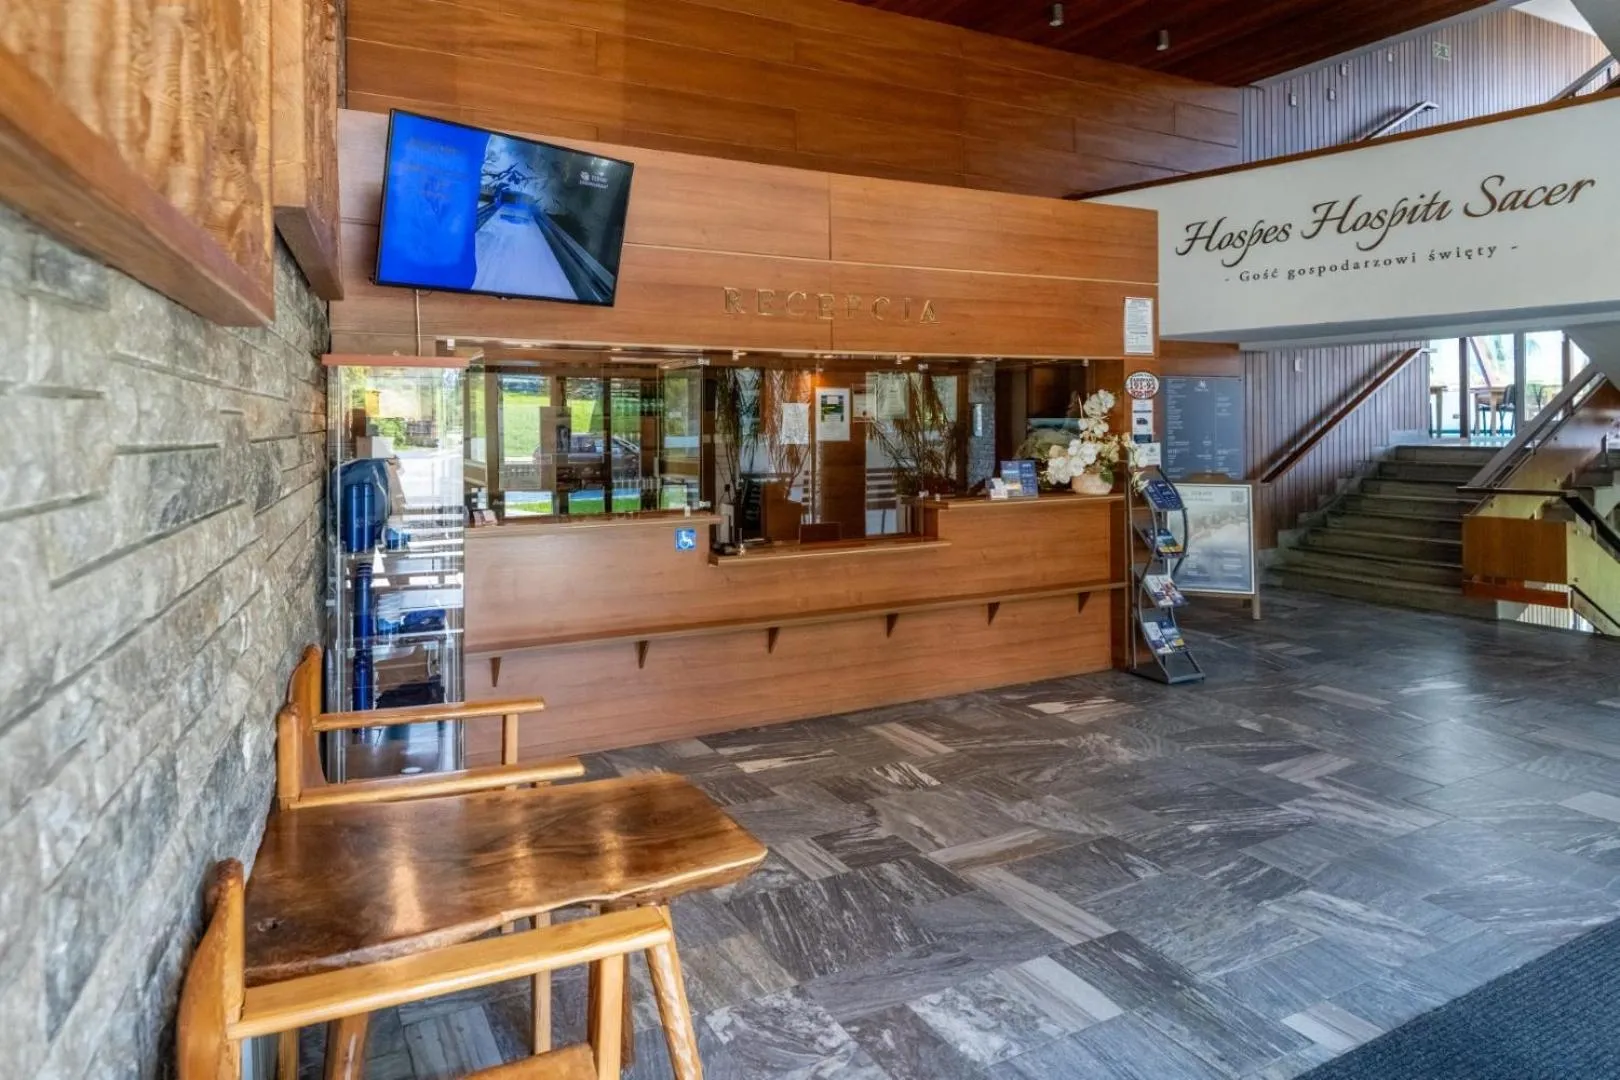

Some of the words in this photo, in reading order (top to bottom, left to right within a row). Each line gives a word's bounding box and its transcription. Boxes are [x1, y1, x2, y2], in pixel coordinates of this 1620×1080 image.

[1175, 216, 1293, 268] Hospes
[1462, 174, 1596, 219] Sacer
[1239, 267, 1281, 284] Gość
[1287, 251, 1418, 281] gospodarzowi
[1427, 243, 1499, 263] święty
